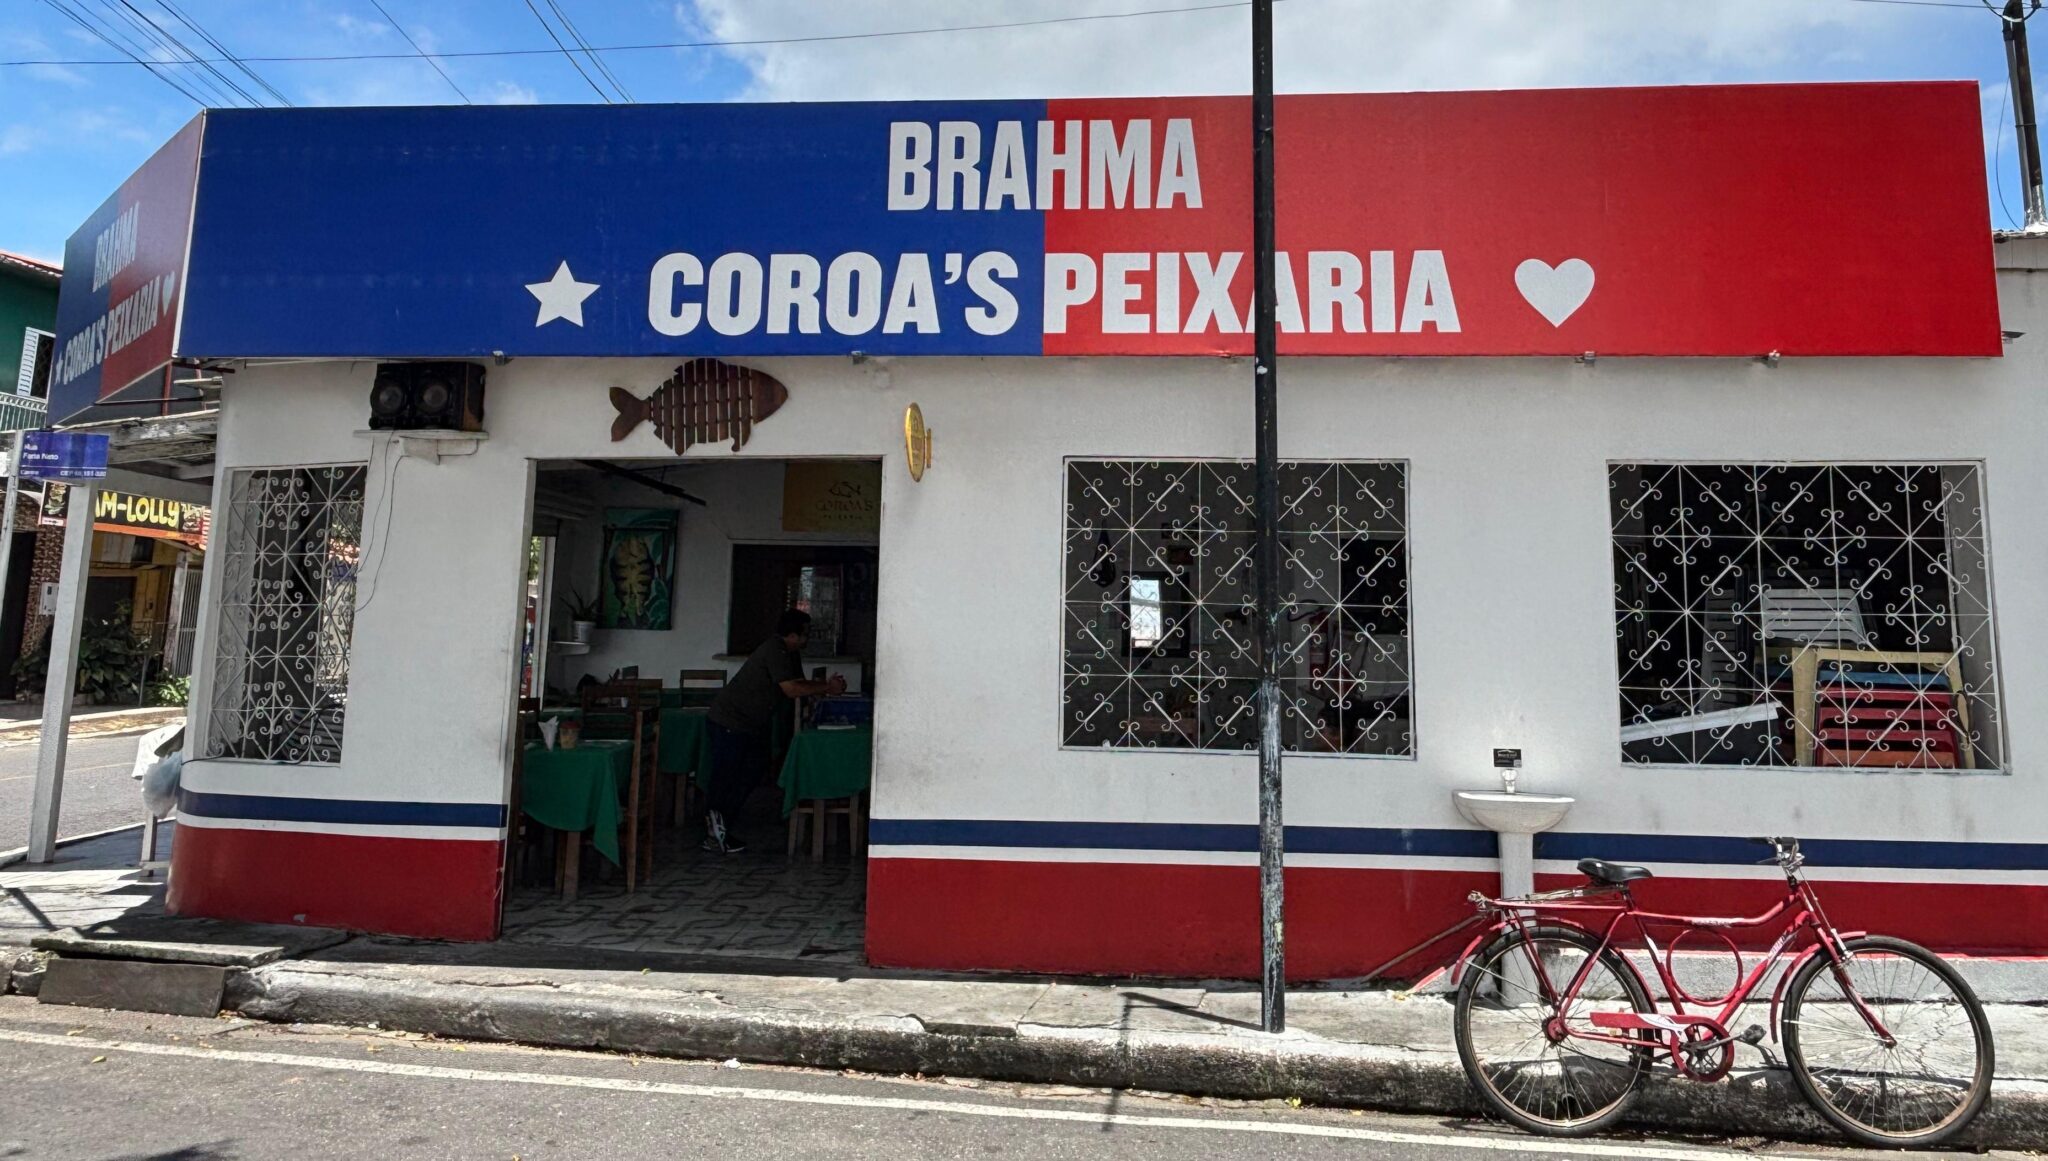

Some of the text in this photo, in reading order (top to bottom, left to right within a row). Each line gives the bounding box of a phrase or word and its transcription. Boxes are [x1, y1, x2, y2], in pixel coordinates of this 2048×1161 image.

[887, 119, 1203, 211] BRAHMA
[93, 201, 140, 293] BRAHMA
[648, 249, 1462, 337] COROA'S PEIXARIA
[63, 274, 161, 386] COROA'S PEIXARIA
[95, 491, 180, 528] M-LOLLY
